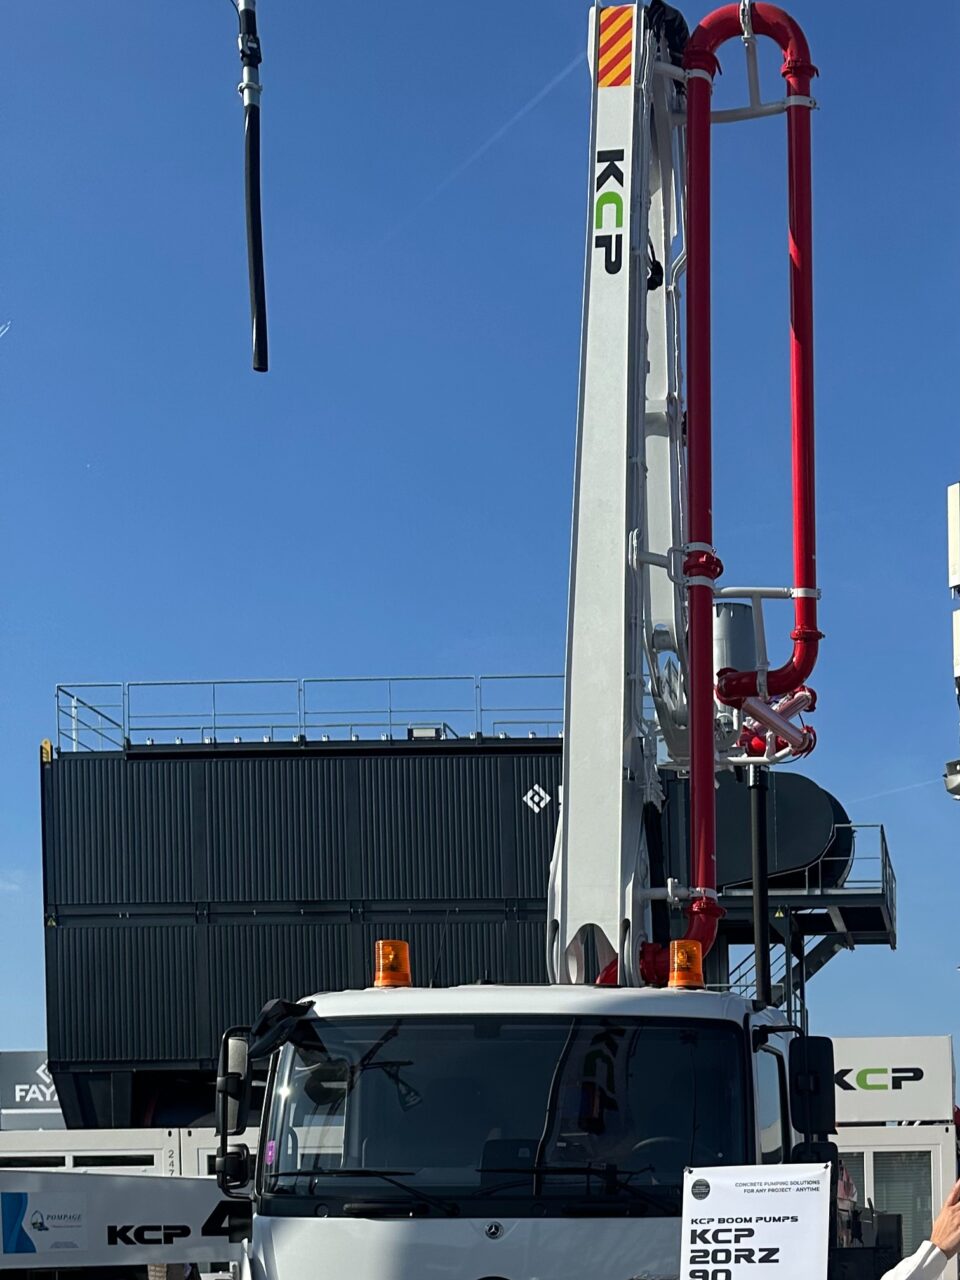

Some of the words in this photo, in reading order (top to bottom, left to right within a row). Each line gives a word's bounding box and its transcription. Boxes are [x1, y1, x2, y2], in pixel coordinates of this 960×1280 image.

[595, 149, 624, 274] KCP
[15, 1084, 58, 1102] FAY
[108, 1225, 191, 1246] KCP
[690, 1228, 755, 1244] KCP
[690, 1248, 780, 1264] 20RZ
